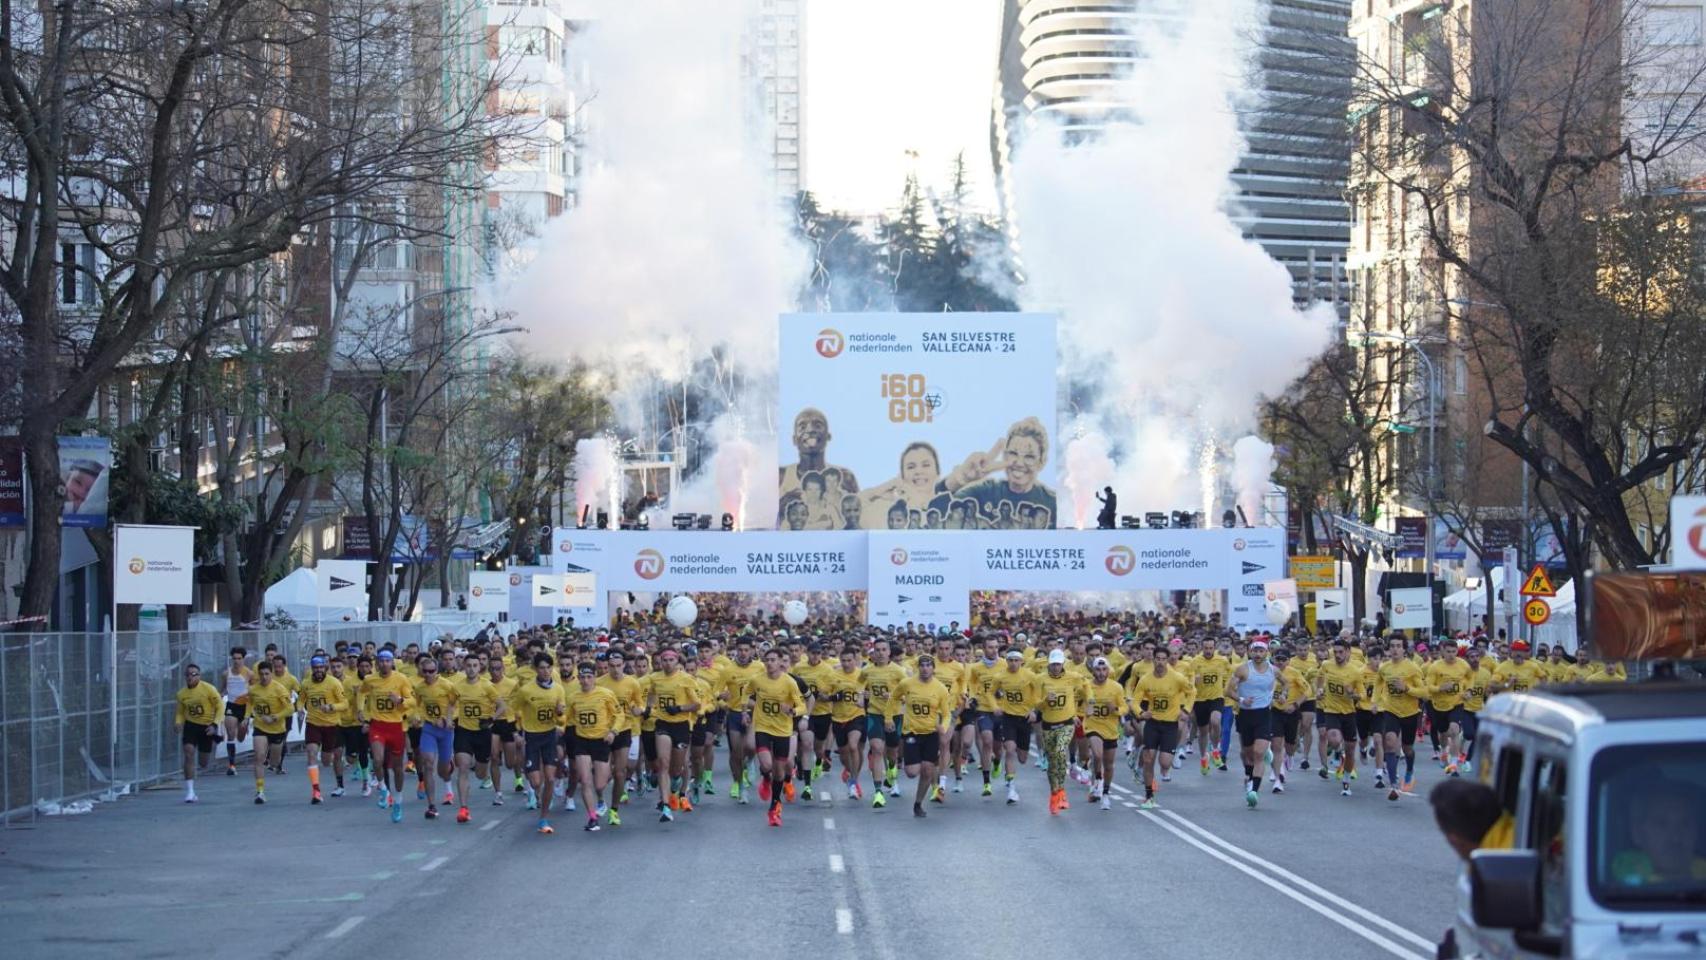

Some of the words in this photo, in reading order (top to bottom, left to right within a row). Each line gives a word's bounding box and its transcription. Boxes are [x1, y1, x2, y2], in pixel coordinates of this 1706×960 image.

[850, 332, 896, 342] nationale
[922, 332, 948, 342] SAN
[950, 332, 1016, 342] SILVESTRE
[850, 343, 913, 353] nederlanden
[922, 343, 991, 353] VALLECANA
[1002, 343, 1016, 353] 24
[670, 553, 720, 562] nationale
[747, 552, 773, 563] SAN
[777, 552, 845, 563] SILVESTRE
[986, 549, 1013, 559] SAN
[1016, 549, 1084, 559] SILVESTRE
[1141, 548, 1191, 559] nationale
[670, 564, 737, 574] nederlanden
[747, 564, 820, 574] VALLECANA
[832, 564, 845, 573] 24
[986, 560, 1059, 570] VALLECANA
[1071, 560, 1085, 570] 24
[1141, 559, 1208, 570] nederlanden
[895, 575, 944, 585] MADRID
[1529, 606, 1544, 617] 30
[1203, 674, 1218, 684] 60
[1329, 683, 1344, 695] 60
[376, 699, 394, 710] 60
[762, 702, 780, 714] 60
[1153, 700, 1168, 710] 60
[426, 705, 441, 716] 60
[464, 706, 481, 716] 60
[537, 709, 554, 721] 60
[579, 712, 597, 725] 60
